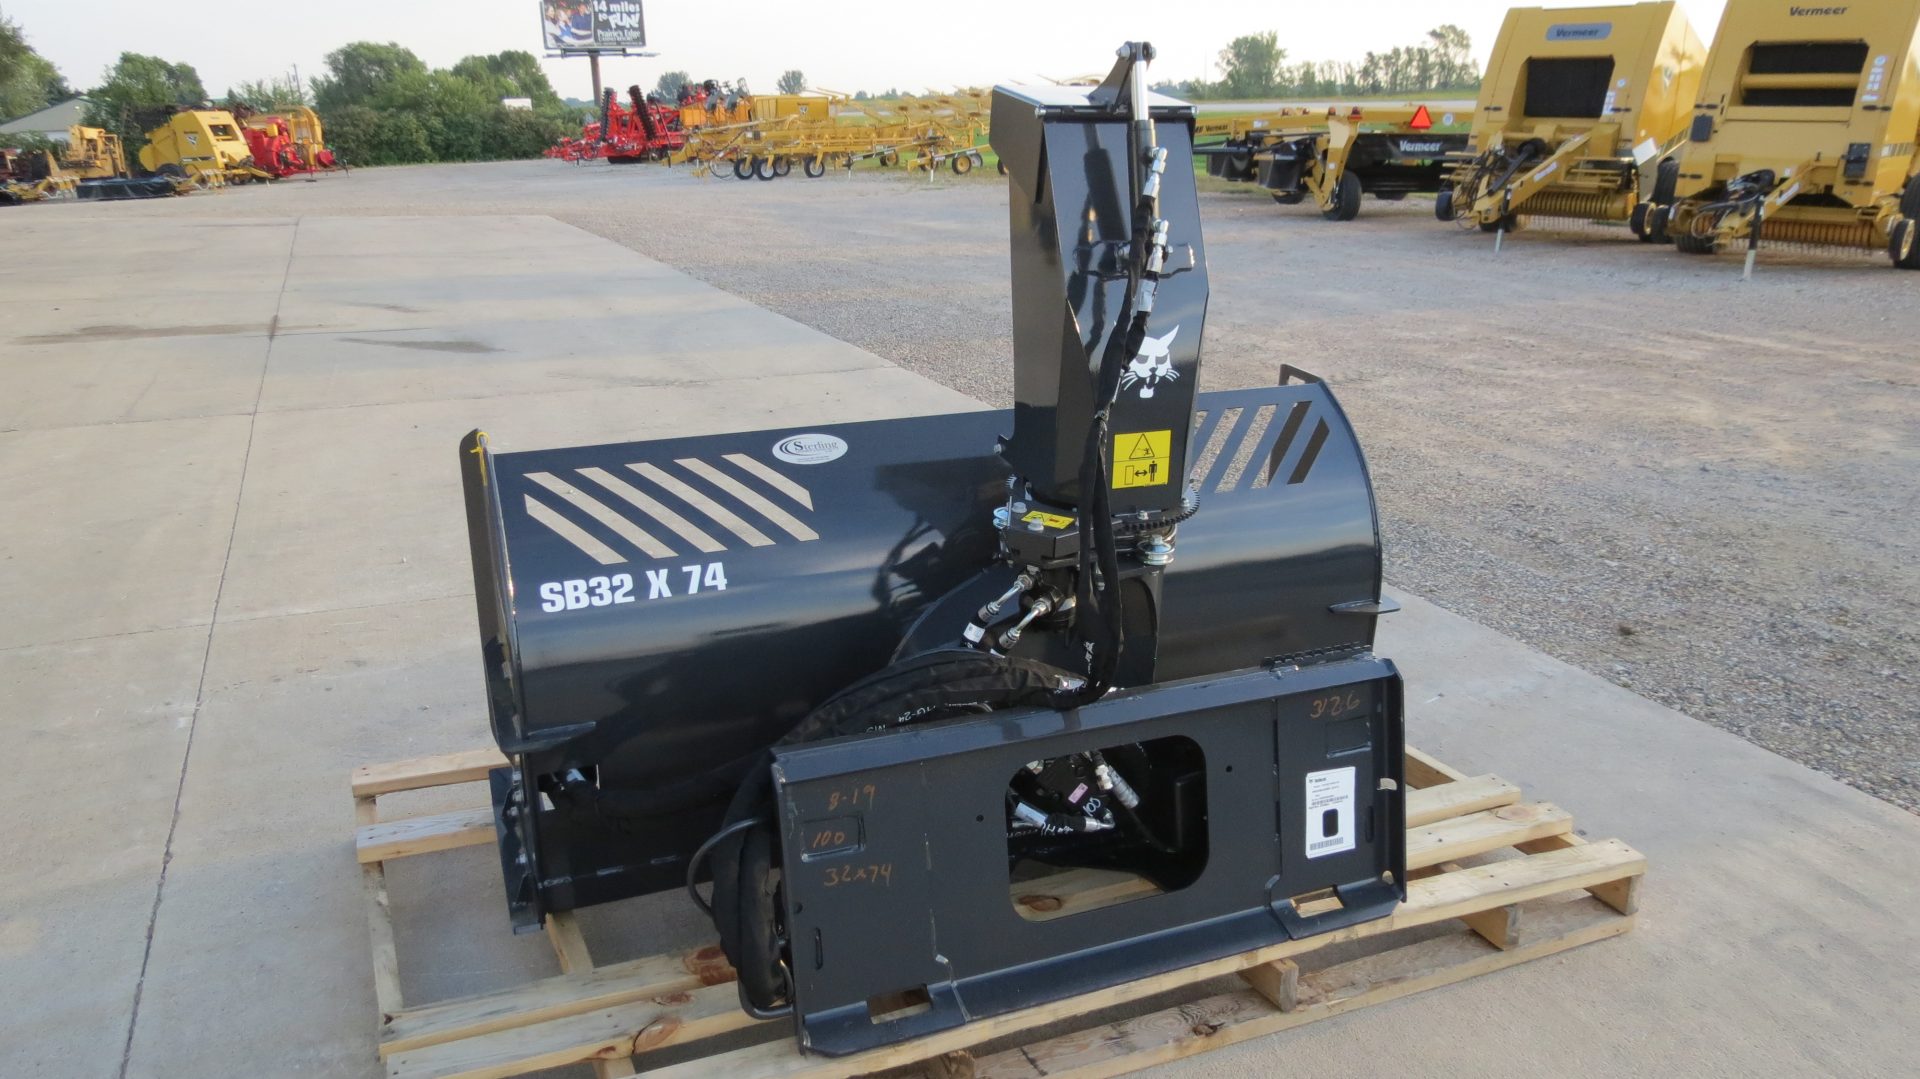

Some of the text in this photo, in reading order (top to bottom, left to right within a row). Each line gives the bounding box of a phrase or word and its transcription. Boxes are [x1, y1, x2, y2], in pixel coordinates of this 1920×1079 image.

[593, 0, 640, 12] 14 miles
[1790, 6, 1848, 16] Vermeer
[1556, 28, 1600, 38] Vermeer
[1400, 140, 1442, 152] Vermeer
[540, 562, 727, 613] SB32 X 74
[812, 831, 845, 849] 100
